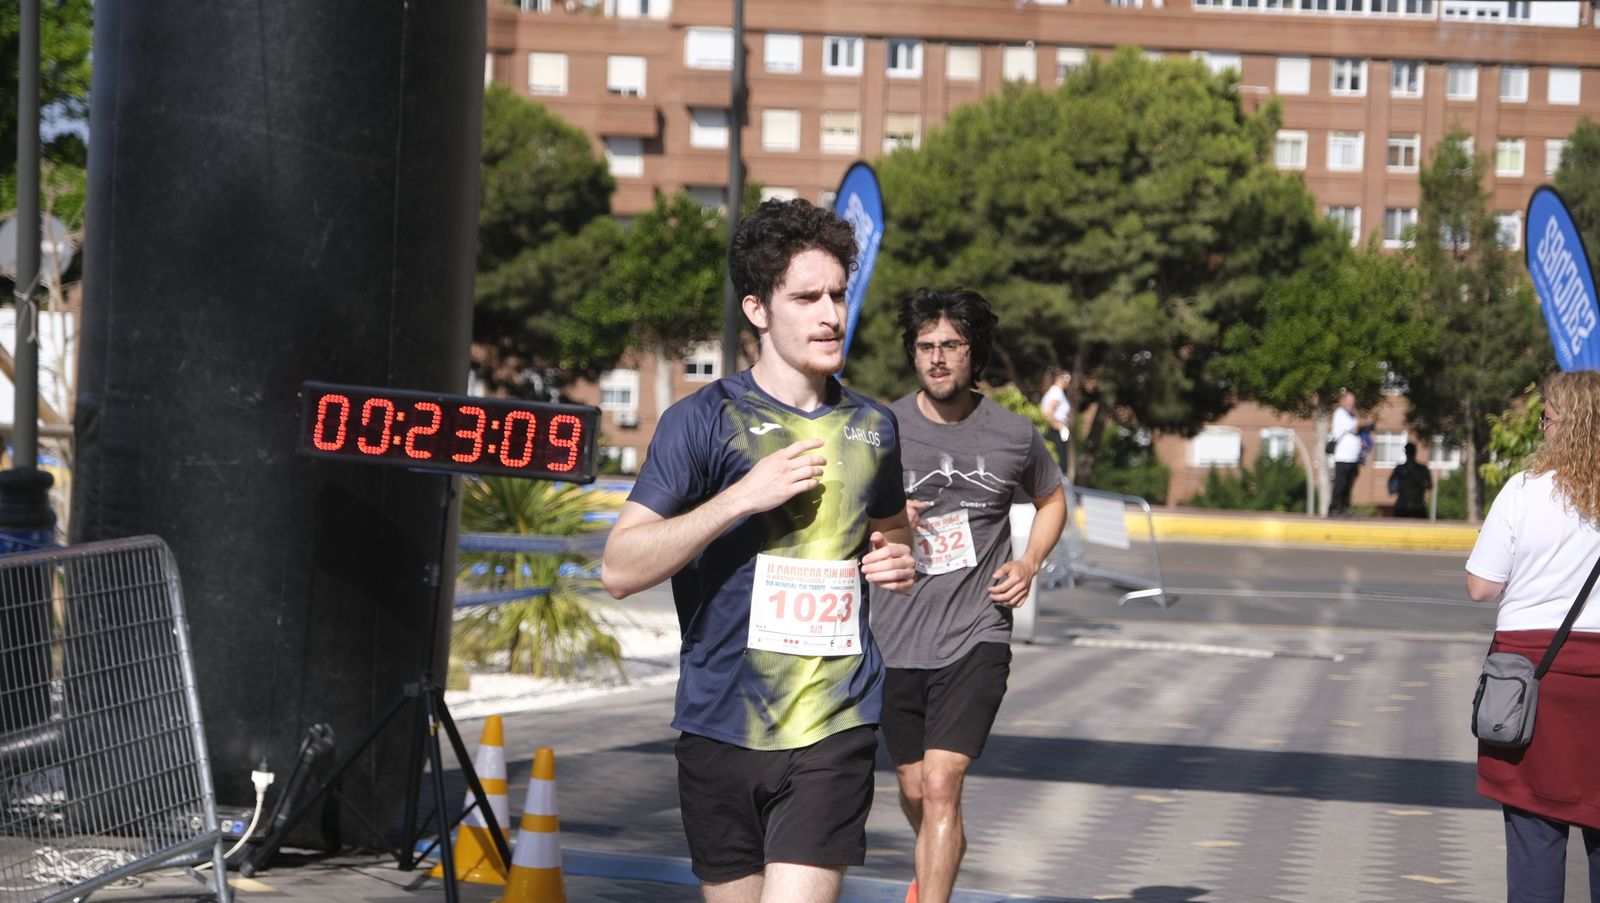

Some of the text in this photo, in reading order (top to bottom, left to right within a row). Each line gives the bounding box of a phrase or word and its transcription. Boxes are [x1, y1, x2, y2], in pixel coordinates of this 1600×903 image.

[313, 393, 582, 472] 00:23:09
[844, 425, 881, 447] CARLOS
[823, 568, 838, 578] SIN
[768, 590, 854, 623] 1023
